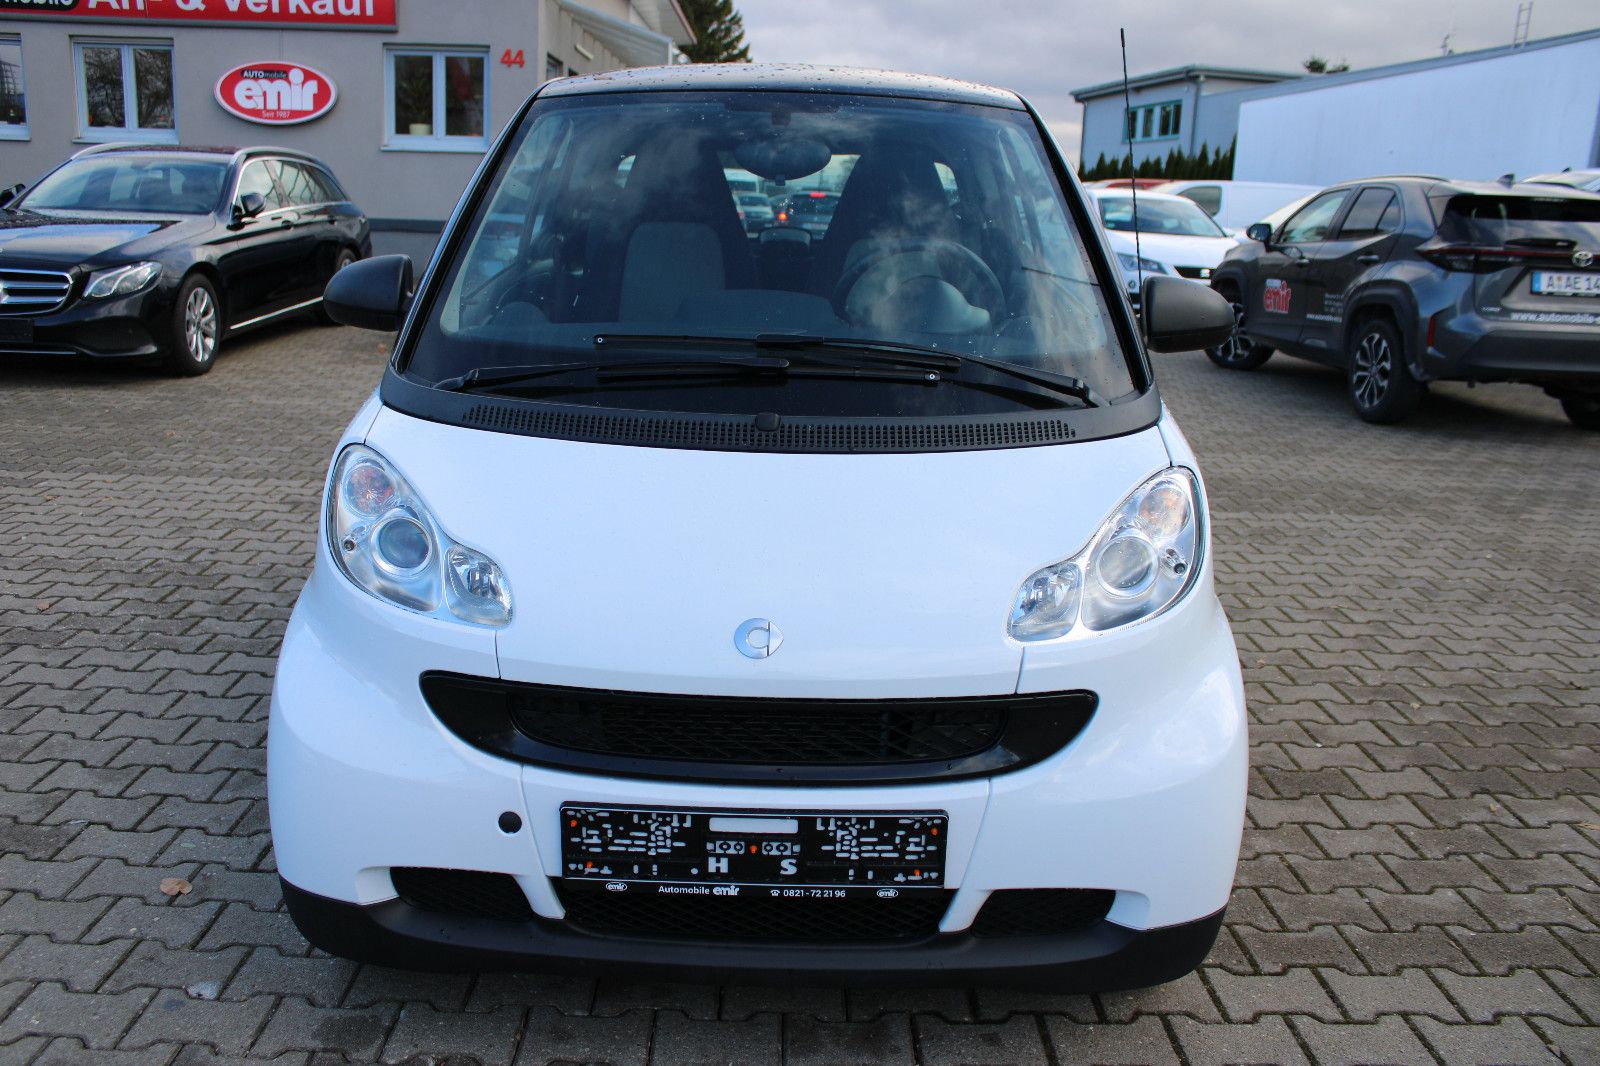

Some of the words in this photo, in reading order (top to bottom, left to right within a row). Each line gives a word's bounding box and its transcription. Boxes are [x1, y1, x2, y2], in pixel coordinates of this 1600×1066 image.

[500, 48, 525, 68] 44
[234, 68, 318, 111] emir
[658, 885, 710, 895] Automobile
[712, 884, 740, 896] emir
